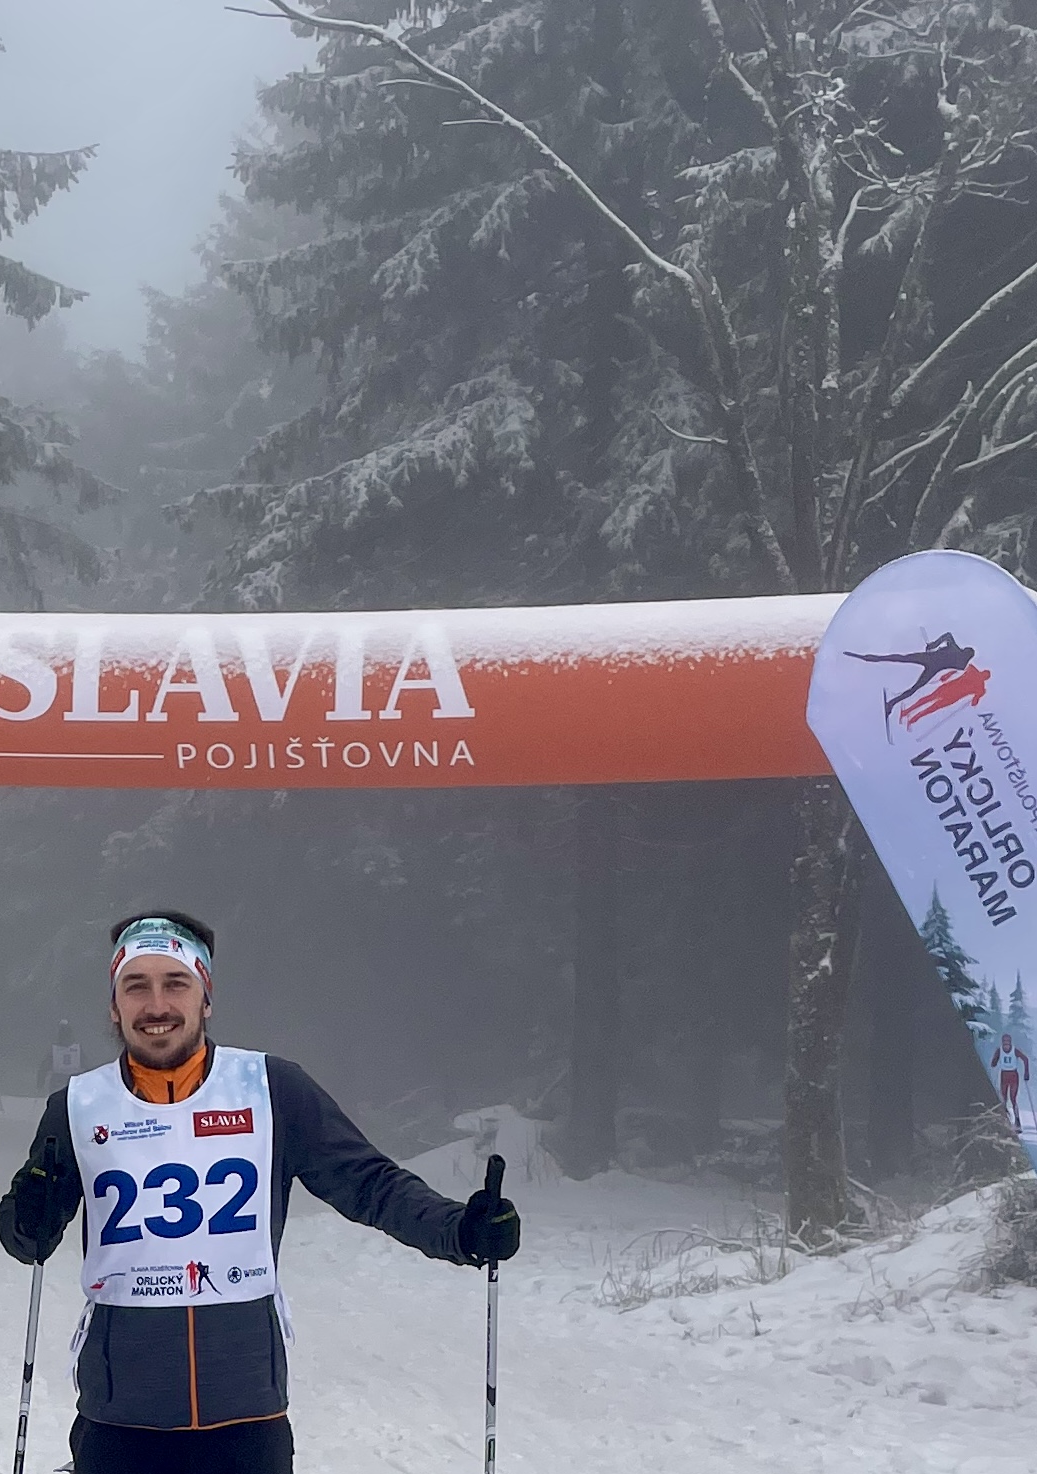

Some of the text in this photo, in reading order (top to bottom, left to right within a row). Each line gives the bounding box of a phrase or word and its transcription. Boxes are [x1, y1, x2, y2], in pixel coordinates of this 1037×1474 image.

[177, 737, 475, 769] POJIŠŤOVNA
[200, 1114, 246, 1127] SLAVIA
[93, 1157, 258, 1247] 232
[136, 1273, 183, 1285] ORLICKÝ
[131, 1286, 183, 1296] MARATON
